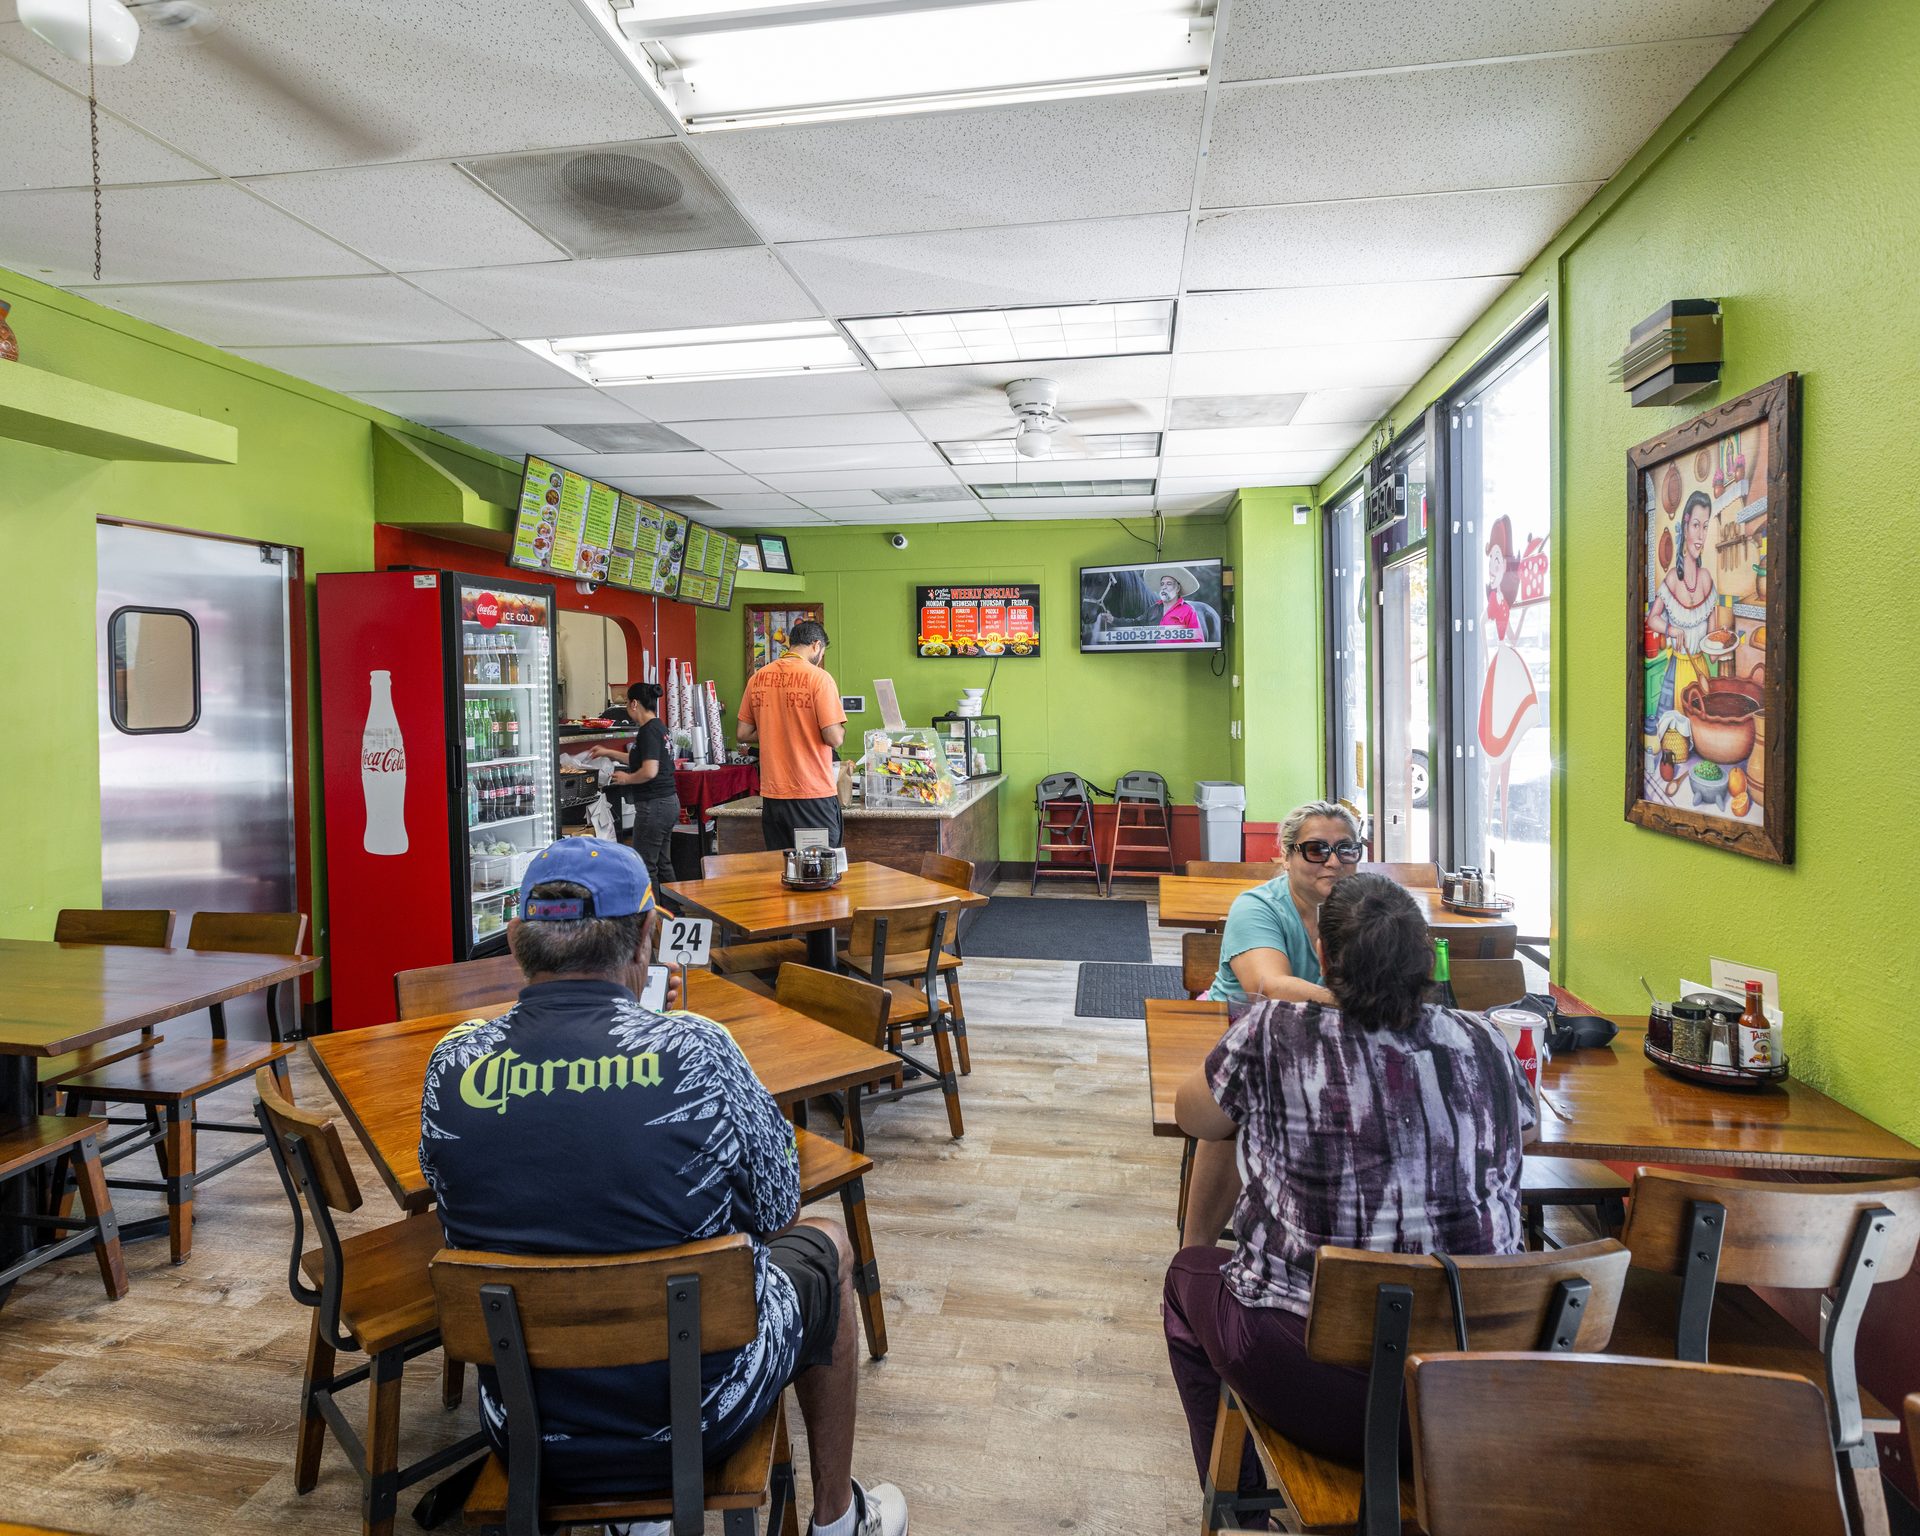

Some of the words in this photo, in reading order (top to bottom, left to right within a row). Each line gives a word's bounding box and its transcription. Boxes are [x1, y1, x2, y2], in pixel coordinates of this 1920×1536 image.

[951, 589, 982, 600] WEEKLY
[983, 587, 1019, 599] SPECIALS
[477, 603, 498, 617] Coca-Cola
[979, 599, 1005, 607] THURSDAY
[502, 611, 515, 621] ICE
[516, 613, 535, 623] COLD
[1105, 629, 1194, 641] 1-800-912-9385
[753, 671, 809, 689] AMERICANA
[786, 692, 812, 709] 1952
[670, 922, 703, 952] 24
[460, 1047, 665, 1116] Corona
